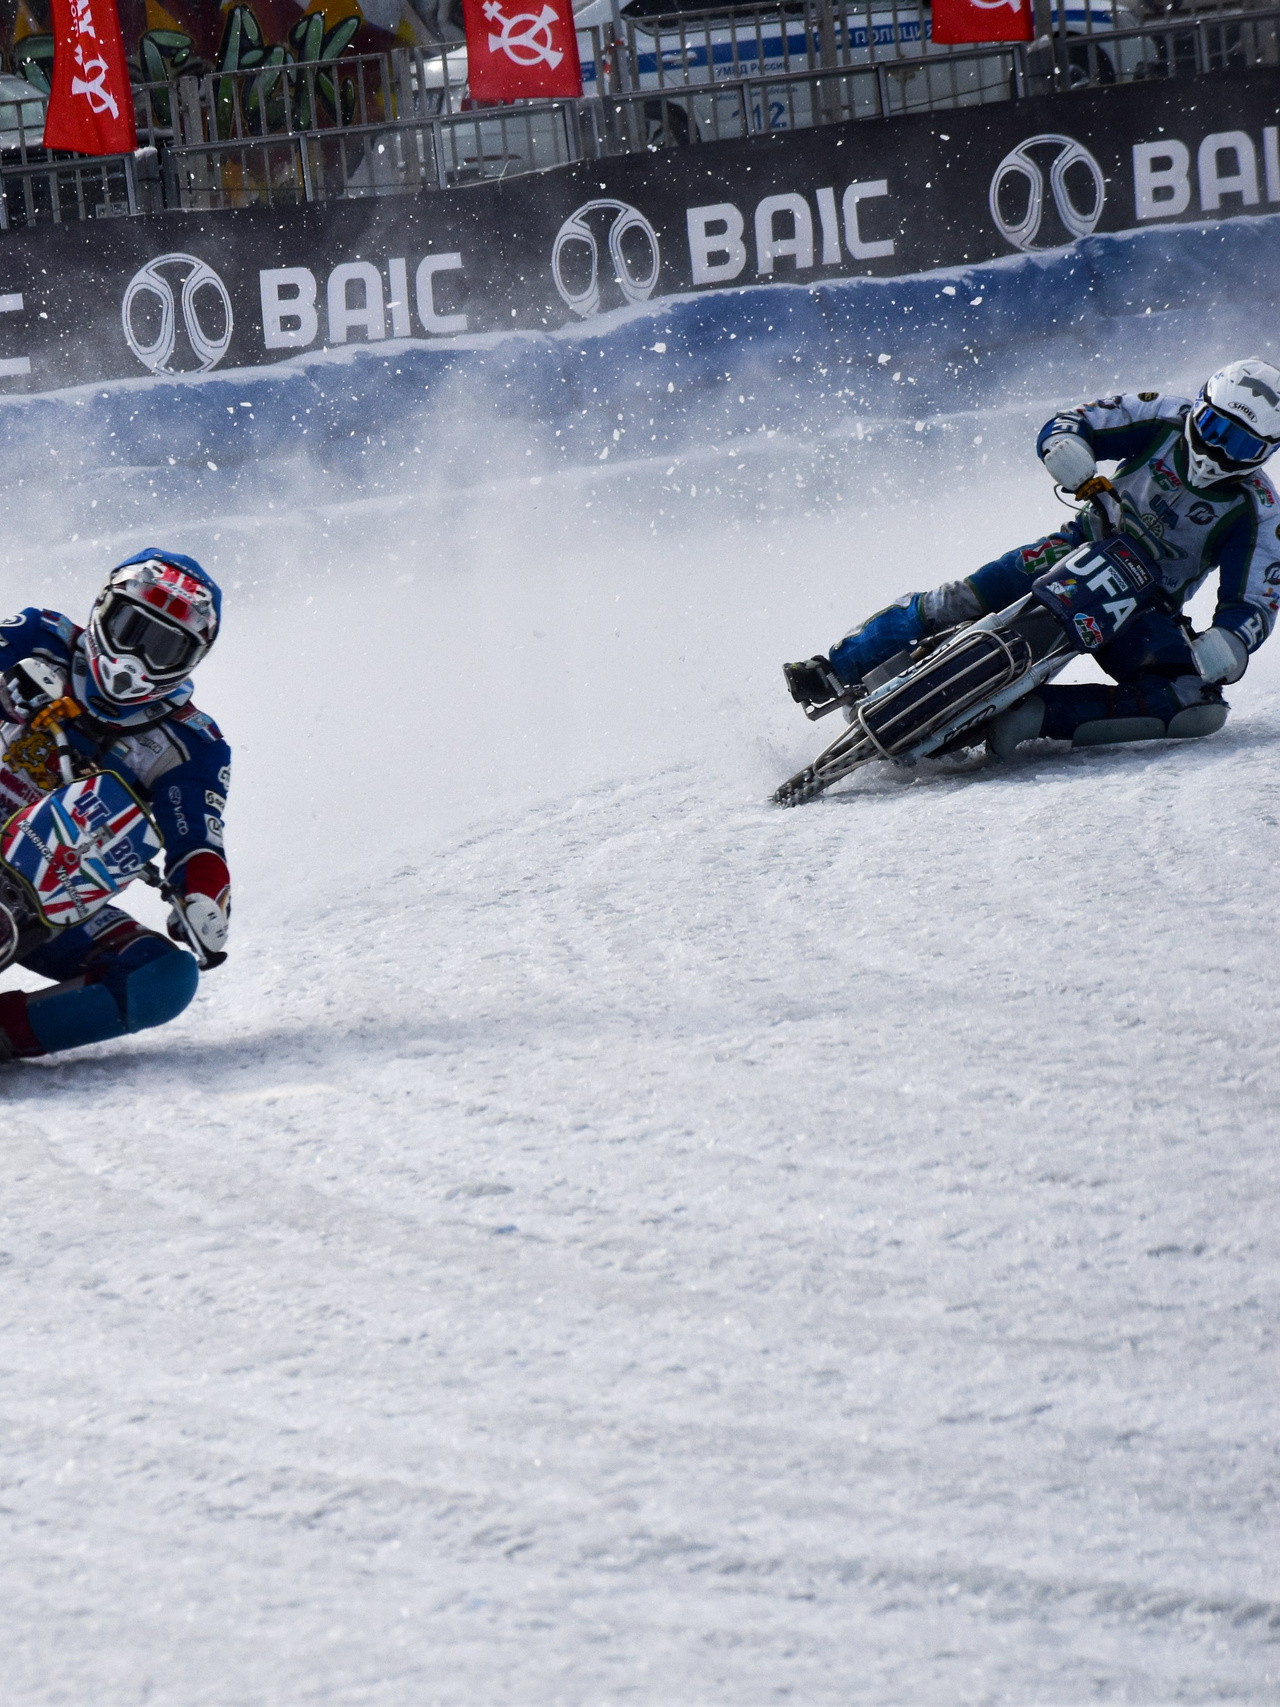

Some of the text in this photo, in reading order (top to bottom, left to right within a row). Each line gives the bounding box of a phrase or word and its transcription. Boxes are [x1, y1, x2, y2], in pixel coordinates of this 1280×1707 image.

[686, 179, 895, 286] BAIC
[259, 252, 468, 349] BAIC
[1233, 402, 1256, 422] SHOEI
[1065, 547, 1138, 633] UFA
